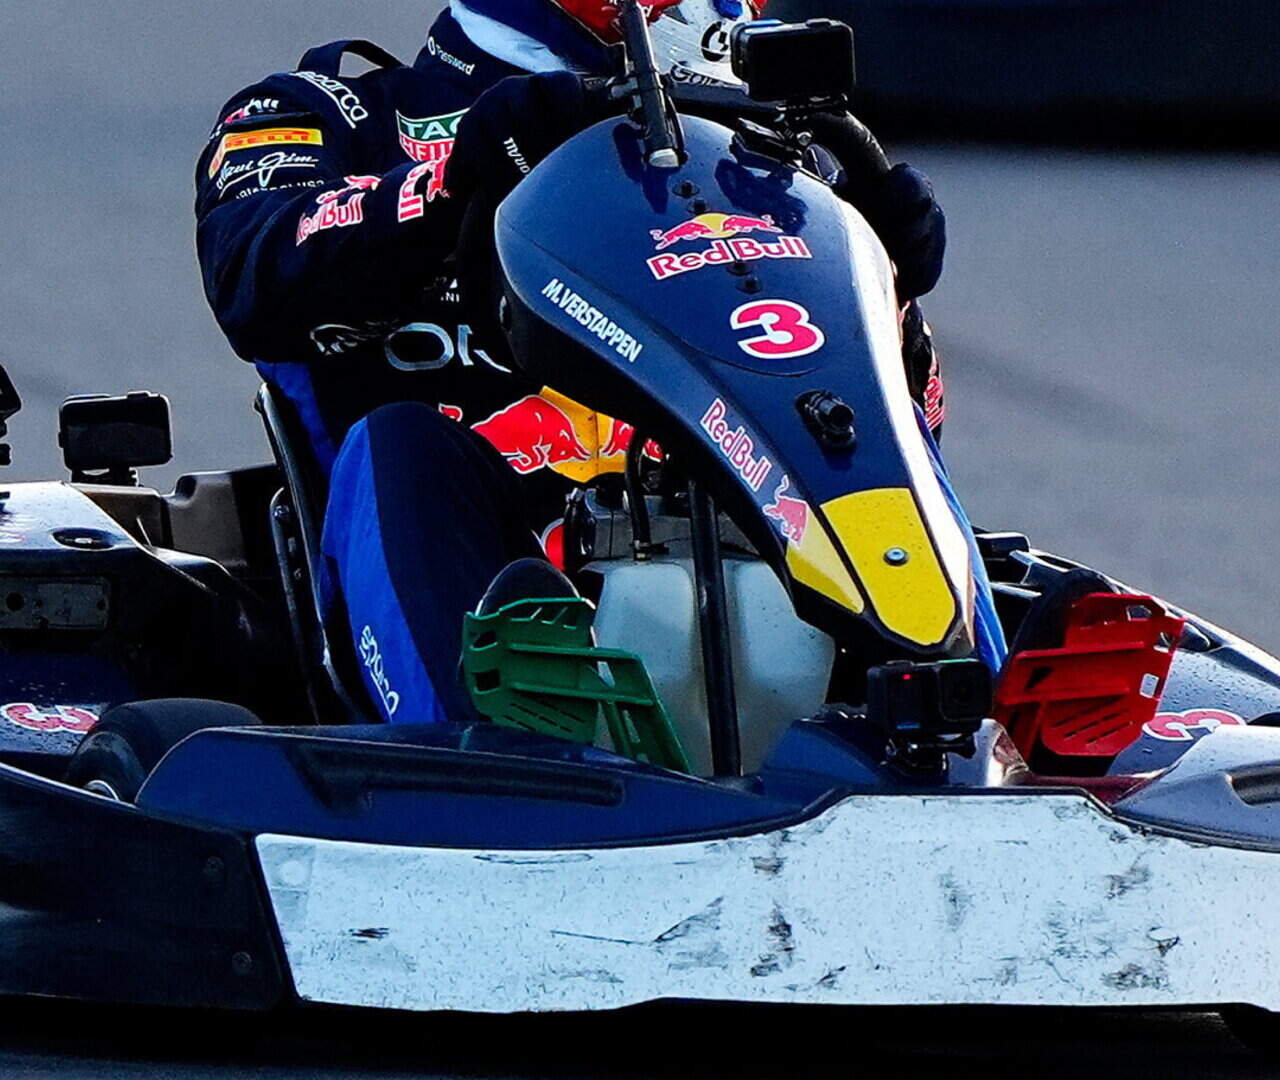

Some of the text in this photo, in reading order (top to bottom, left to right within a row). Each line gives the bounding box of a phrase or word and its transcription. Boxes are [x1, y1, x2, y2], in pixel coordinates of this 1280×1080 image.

[320, 192, 366, 227] Bull
[648, 236, 812, 279] Red Bull
[541, 278, 643, 362] M.VERSTAPPEN
[730, 299, 825, 359] 3
[700, 398, 771, 492] Red Bull
